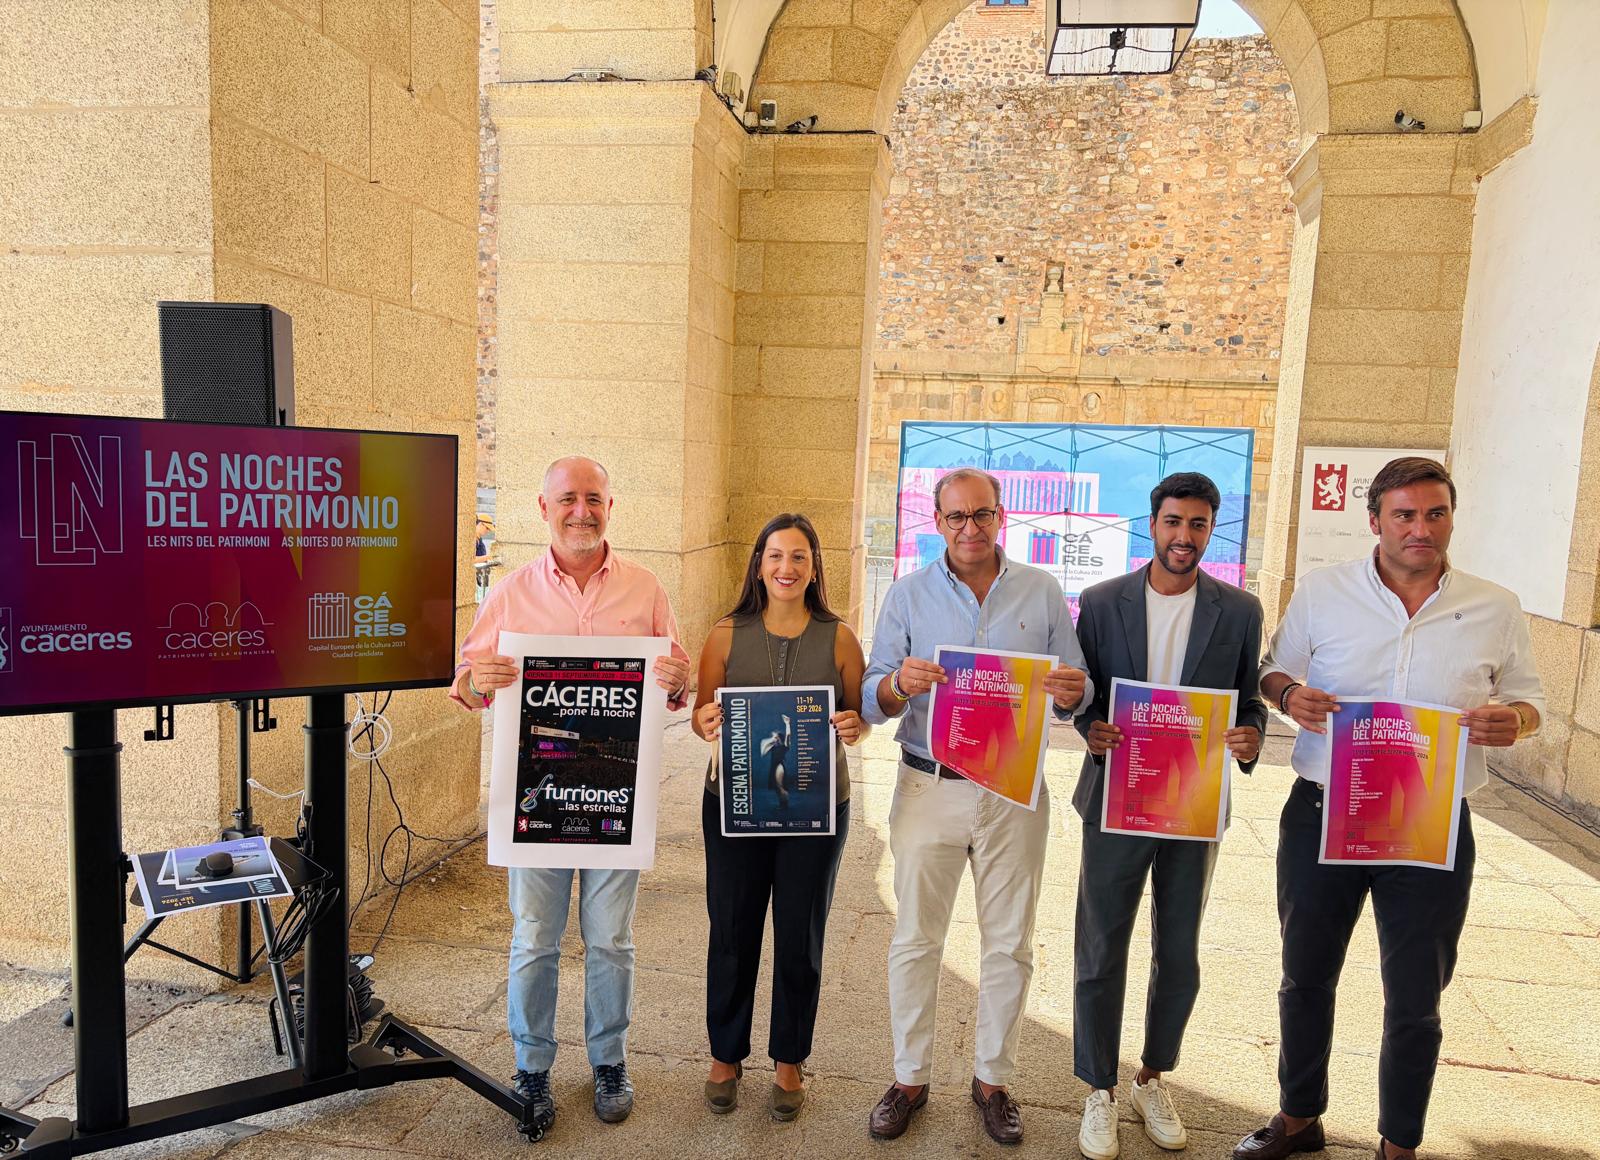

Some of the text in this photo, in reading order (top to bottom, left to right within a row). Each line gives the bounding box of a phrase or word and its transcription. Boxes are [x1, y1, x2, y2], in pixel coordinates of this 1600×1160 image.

[145, 450, 342, 492] LAS NOCHES
[146, 491, 398, 529] DEL PATRIMONIO
[147, 536, 270, 547] LES NITS DEL PATRIMONI
[281, 536, 398, 548] AS NOITES DO PATRIMONIO
[1062, 544, 1090, 555] CE
[1062, 555, 1104, 566] RES
[353, 591, 393, 609] CÁ
[353, 609, 390, 624] CE
[20, 624, 88, 633] AYUNTAMIENTO
[354, 623, 407, 638] RES
[233, 648, 276, 656] HUMANIDAD
[308, 644, 330, 652] Capital
[392, 640, 406, 648] 2031
[354, 650, 384, 658] Candidata
[956, 667, 1009, 682] LAS NOCHES
[955, 678, 972, 690] DEL
[974, 680, 1024, 694] PATRIMONIO
[526, 681, 638, 709] CÁCERES
[796, 696, 814, 704] 11-19
[590, 708, 600, 716] la
[603, 708, 636, 718] noche
[808, 704, 822, 712] 2026
[1132, 701, 1187, 716] LAS NOCHES
[1132, 712, 1148, 722] DEL
[1150, 712, 1204, 727] PATRIMONIO
[1353, 718, 1412, 731] LAS NOCHES
[730, 698, 747, 773] PATRIMONIO
[1352, 730, 1369, 740] DEL
[1372, 729, 1430, 745] PATRIMONIO
[732, 774, 749, 815] ESCENA
[582, 803, 627, 813] estrellas
